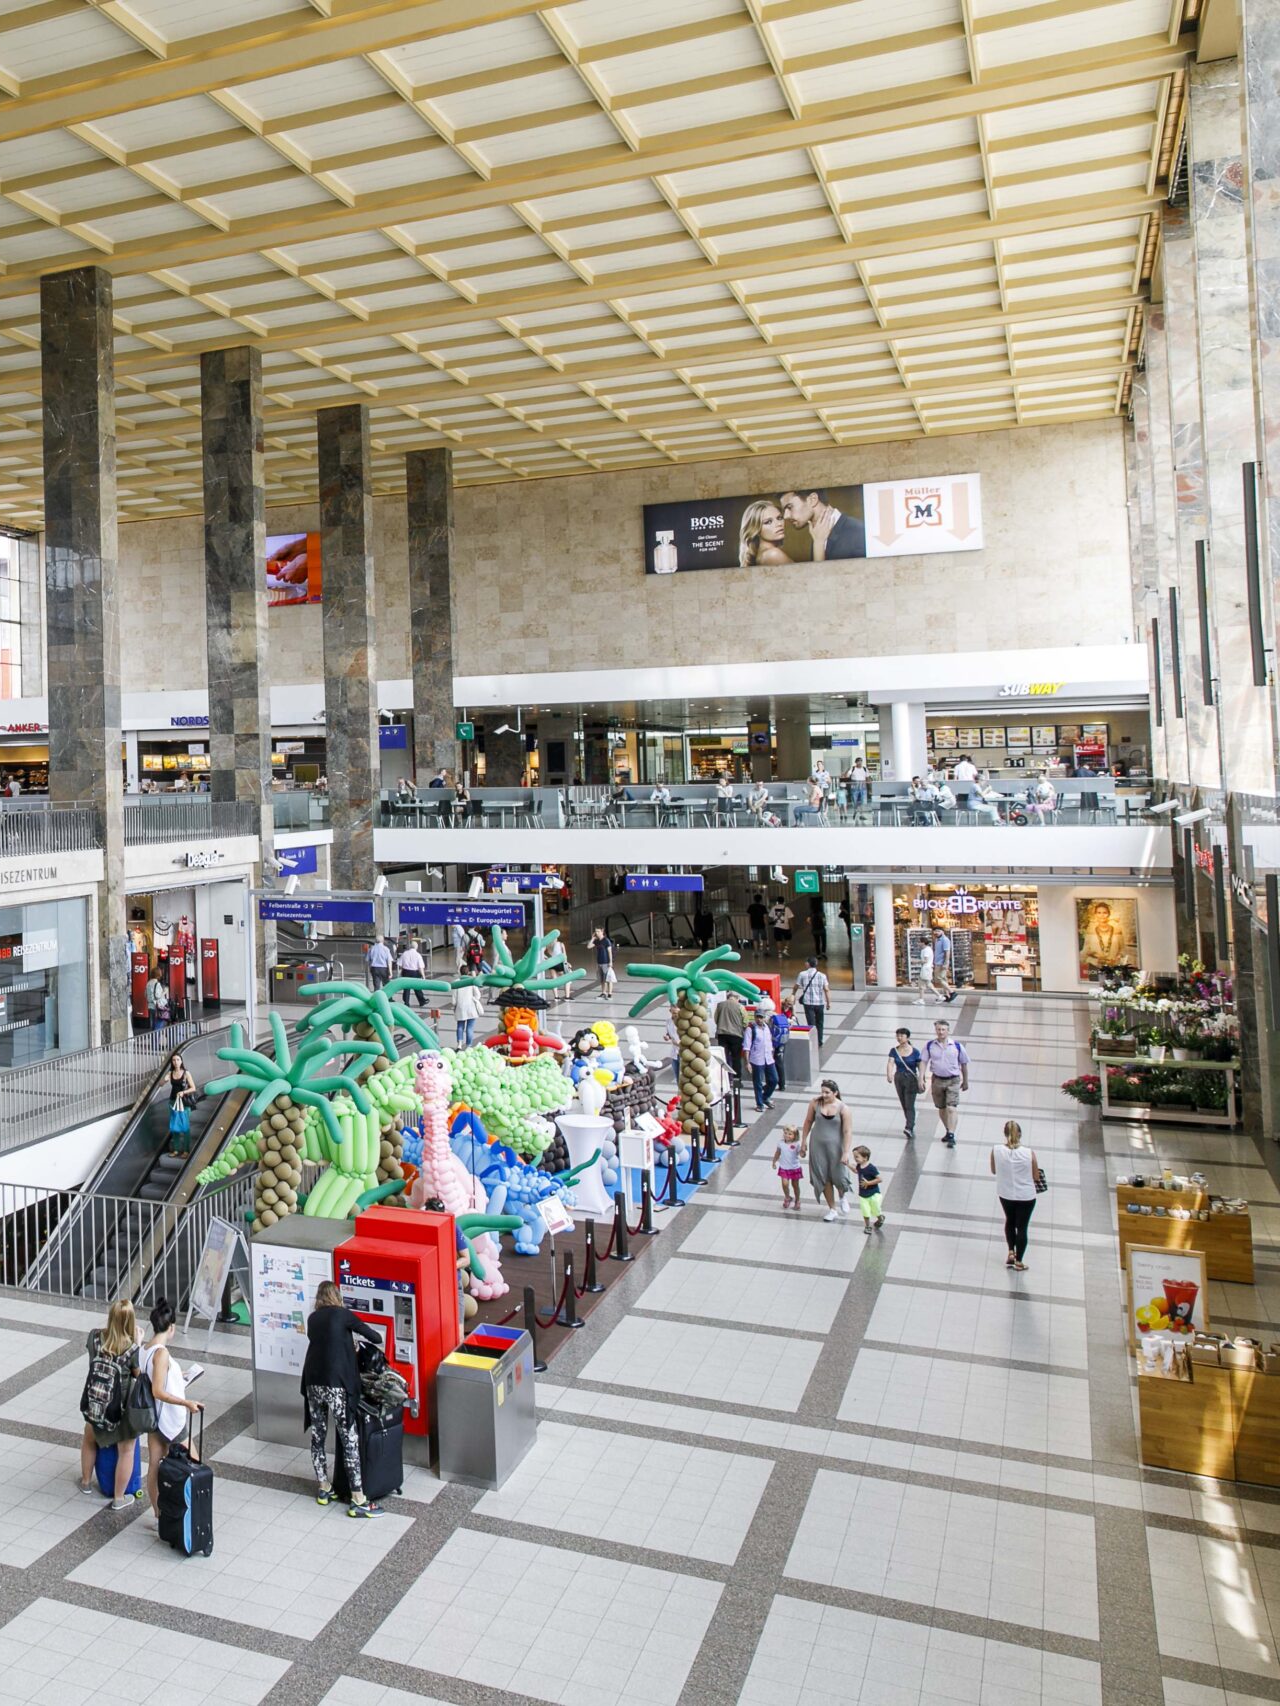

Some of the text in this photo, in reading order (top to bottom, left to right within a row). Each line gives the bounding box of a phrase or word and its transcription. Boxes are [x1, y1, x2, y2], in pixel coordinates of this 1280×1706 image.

[914, 503, 933, 518] M
[690, 515, 724, 527] BOSS
[1000, 682, 1066, 696] SUBWAY
[8, 723, 41, 732] ANKER
[913, 899, 948, 910] BIJOU
[471, 907, 512, 915] Neubaugürtel
[344, 1274, 375, 1288] Tickets
